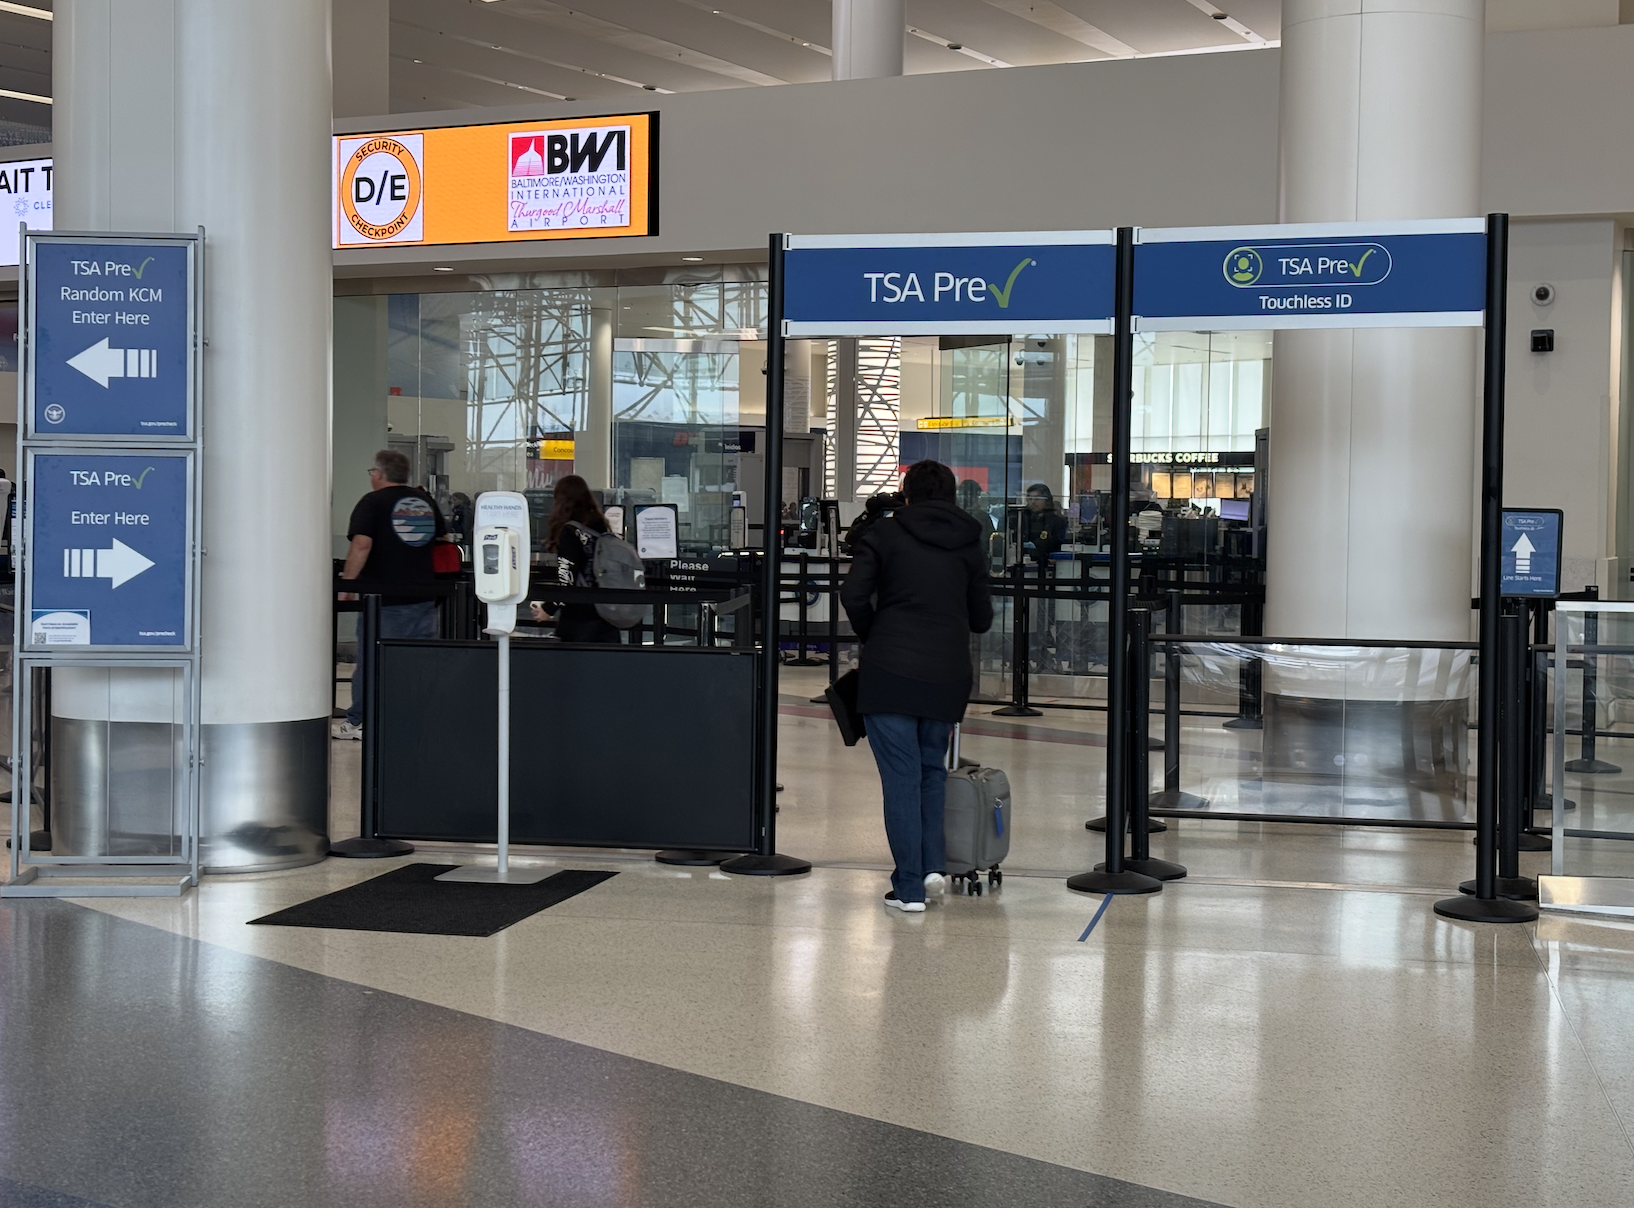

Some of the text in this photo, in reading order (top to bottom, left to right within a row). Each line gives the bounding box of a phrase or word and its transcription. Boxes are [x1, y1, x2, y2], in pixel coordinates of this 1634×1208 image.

[355, 140, 404, 162] SECURITY
[547, 130, 626, 175] BWI
[355, 170, 406, 206] D/E
[511, 173, 626, 189] BALTIMORE/WASHINGTON
[511, 185, 626, 200] INTERNATIONAL
[510, 197, 626, 222] Thurgood Marshall
[351, 211, 409, 237] CHECKPOINT
[511, 213, 624, 229] AIRPORT
[71, 260, 132, 276] TSA Pre
[1278, 256, 1348, 276] TSA Pre
[60, 286, 163, 302] Random KCM
[863, 272, 987, 303] TSA Pre
[1259, 294, 1353, 310] Touchless ID
[72, 310, 150, 326] Enter Here
[1106, 452, 1220, 463] SRBUCKS COFFEE
[70, 470, 132, 487] TSA Pre
[71, 511, 150, 526] Enter Here
[670, 560, 709, 571] Please
